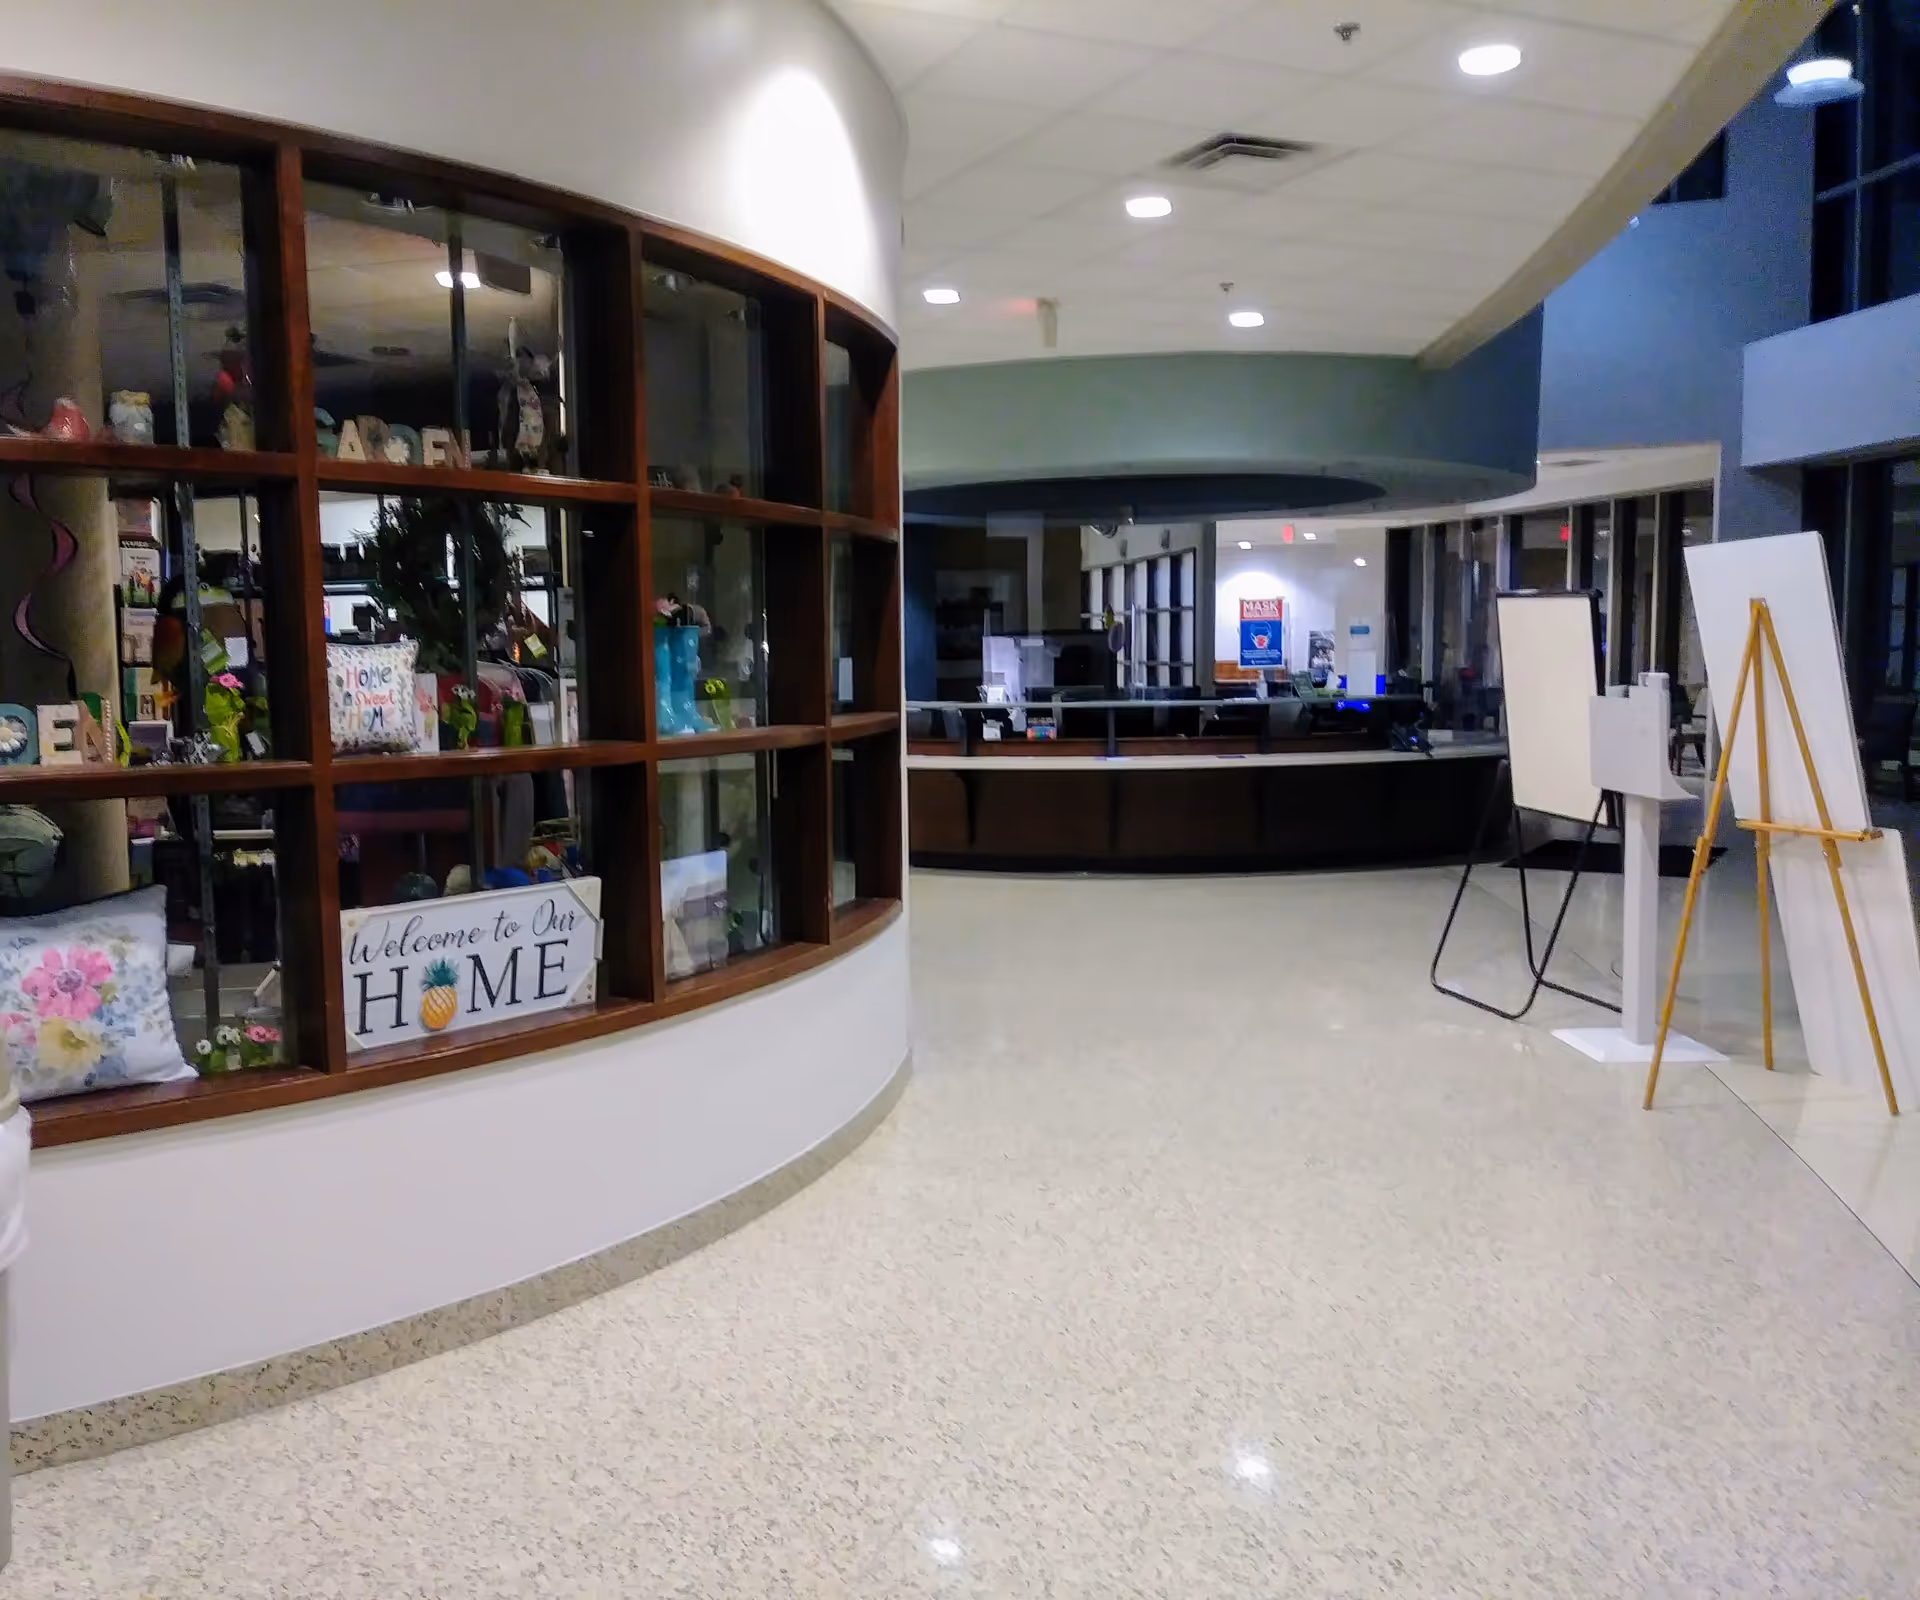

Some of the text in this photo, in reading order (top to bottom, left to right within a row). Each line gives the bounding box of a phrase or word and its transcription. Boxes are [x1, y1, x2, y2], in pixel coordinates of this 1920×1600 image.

[1243, 600, 1278, 612] MASK
[350, 898, 576, 965] Welcome to Our
